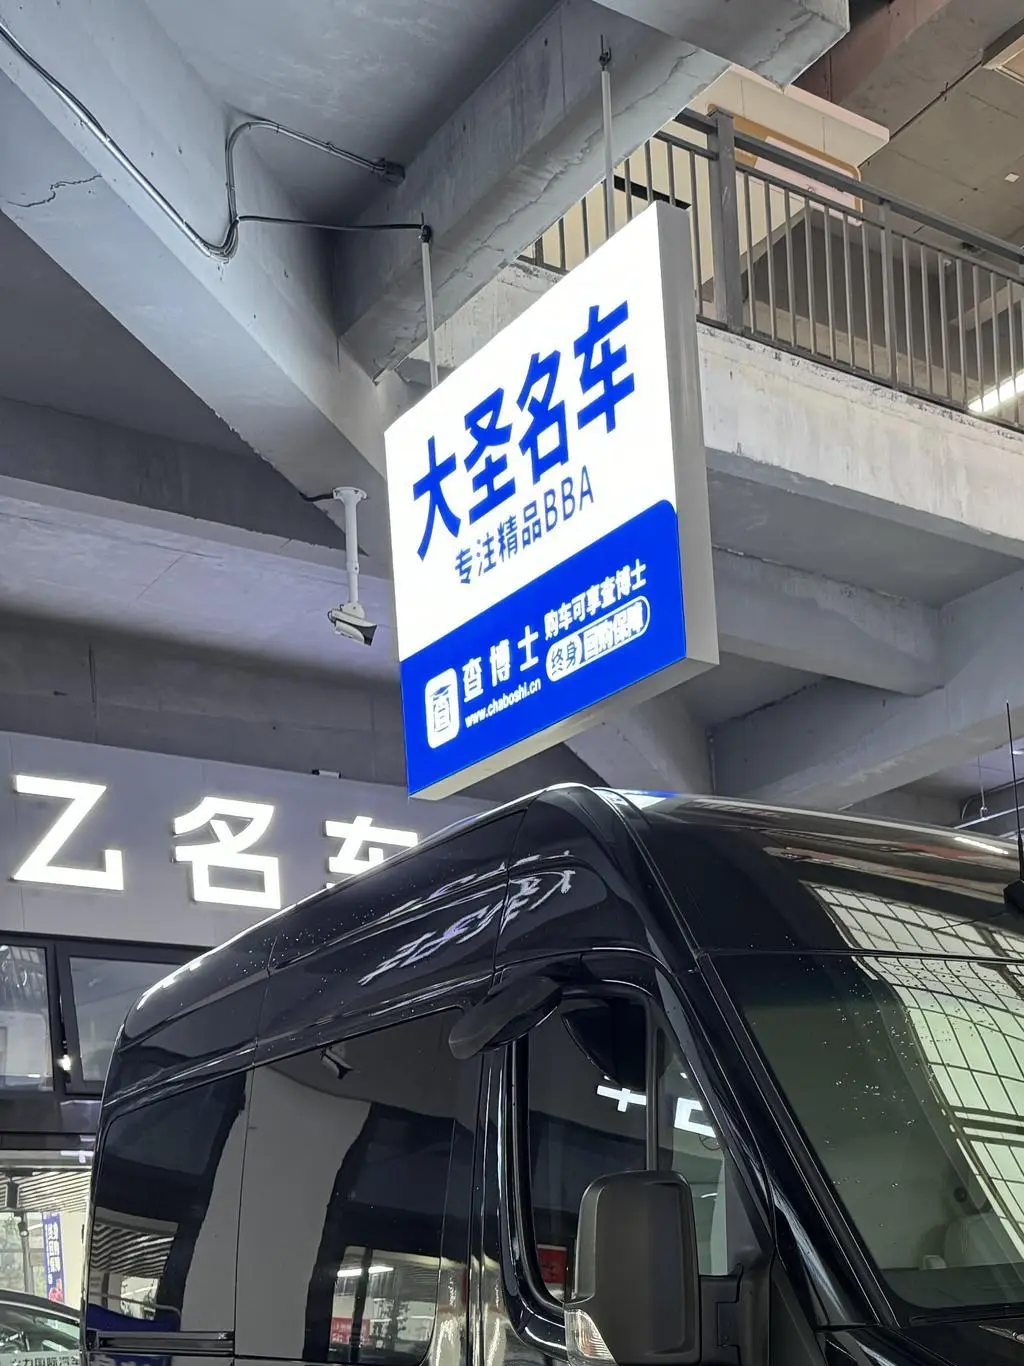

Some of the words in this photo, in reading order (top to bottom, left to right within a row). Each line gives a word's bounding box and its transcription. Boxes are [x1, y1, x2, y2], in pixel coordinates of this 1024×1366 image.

[413, 300, 635, 562] 大圣名车
[455, 465, 594, 584] 专注精品BBA
[544, 558, 647, 640] 购车可享查博士
[462, 625, 539, 703] 查博士
[465, 678, 541, 728] www.chaboshi.cn
